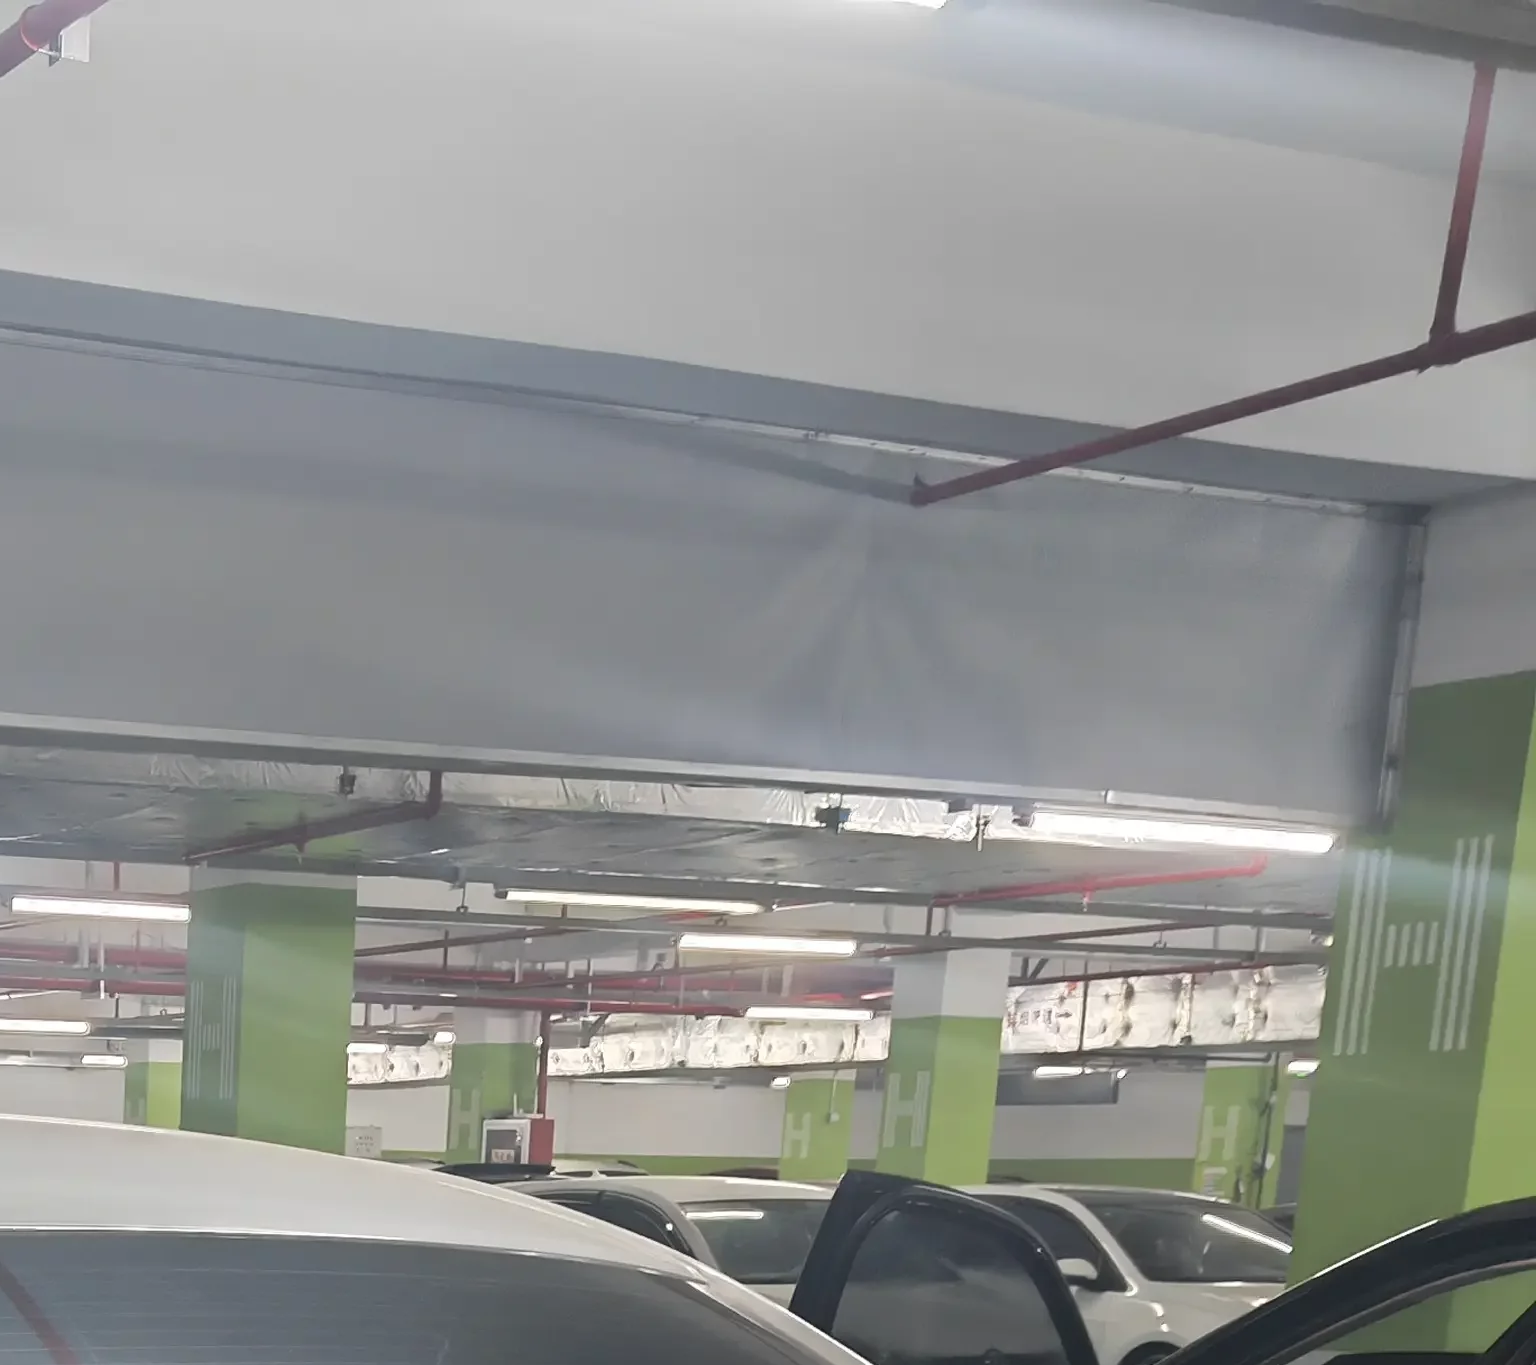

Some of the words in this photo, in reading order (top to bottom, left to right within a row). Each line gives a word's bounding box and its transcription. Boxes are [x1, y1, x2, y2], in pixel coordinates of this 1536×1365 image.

[1333, 835, 1494, 1056] H
[783, 1112, 811, 1159] H
[883, 1071, 931, 1148] H
[1197, 1105, 1241, 1161] H
